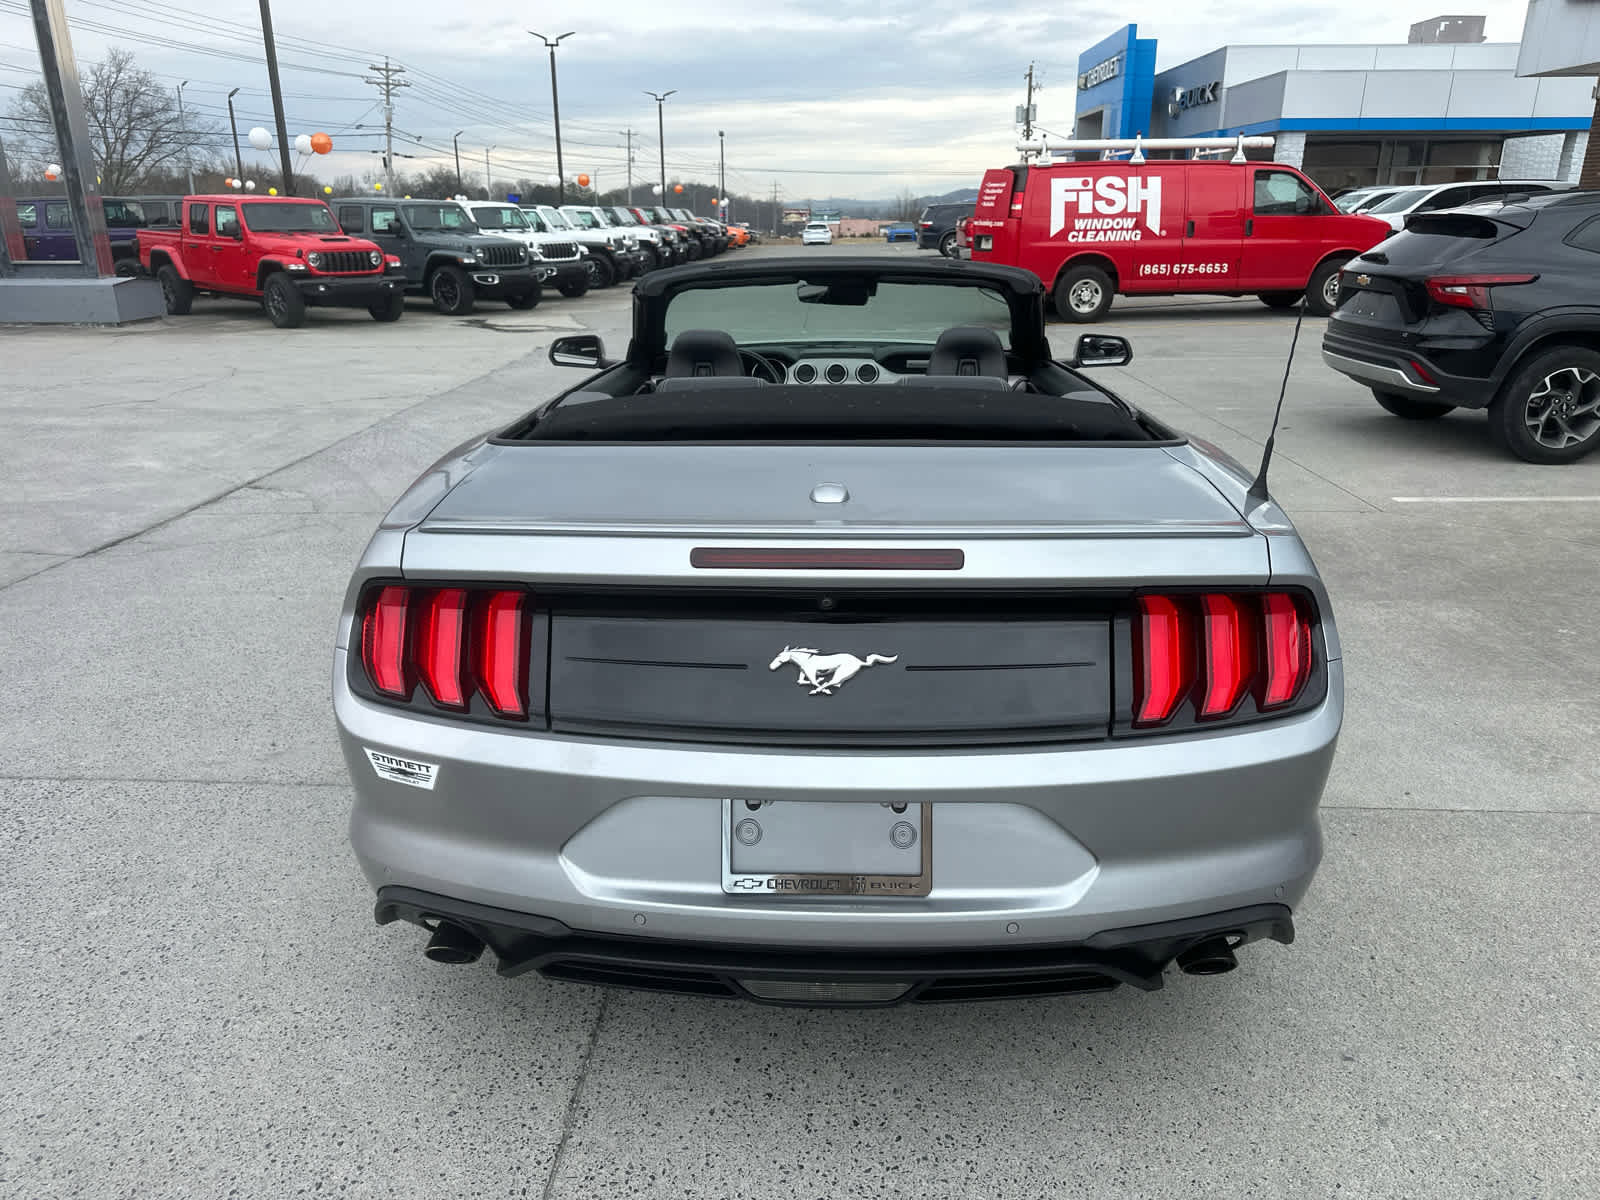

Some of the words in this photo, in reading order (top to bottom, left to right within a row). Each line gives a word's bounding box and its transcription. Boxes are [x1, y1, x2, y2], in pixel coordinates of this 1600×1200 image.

[1074, 217, 1137, 230] WINDOW
[1067, 230, 1142, 242] CLEANING
[1139, 264, 1171, 277] (865)
[1173, 263, 1229, 274] 675-6653
[371, 752, 432, 773] STINNETT
[766, 878, 841, 890] CHEVROLET
[870, 881, 920, 889] BUICK
